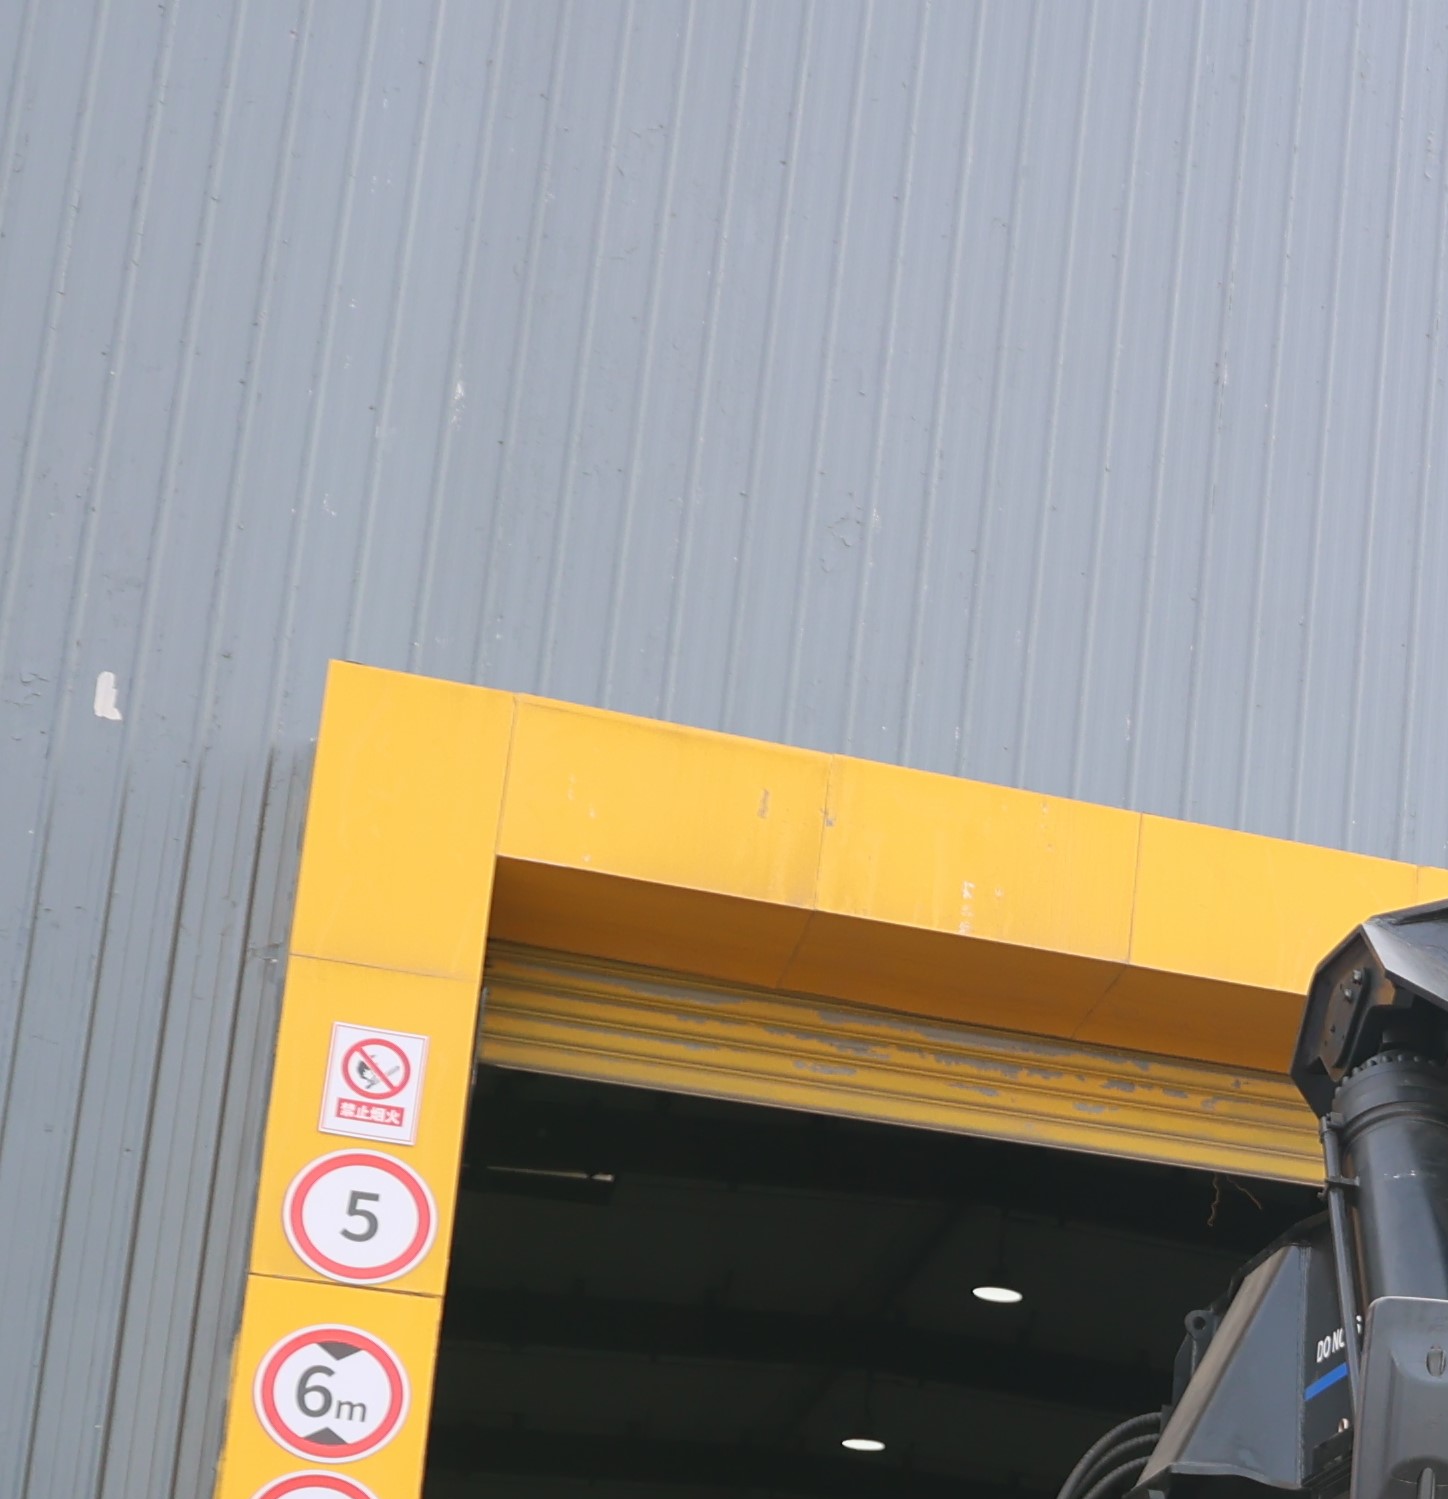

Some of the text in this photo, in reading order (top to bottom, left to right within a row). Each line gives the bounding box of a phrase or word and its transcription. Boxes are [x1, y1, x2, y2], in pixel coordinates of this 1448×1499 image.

[339, 1101, 401, 1125] 禁止烟火
[340, 1190, 380, 1242] 5
[1316, 1327, 1345, 1363] DO NO
[295, 1364, 368, 1423] 6m
